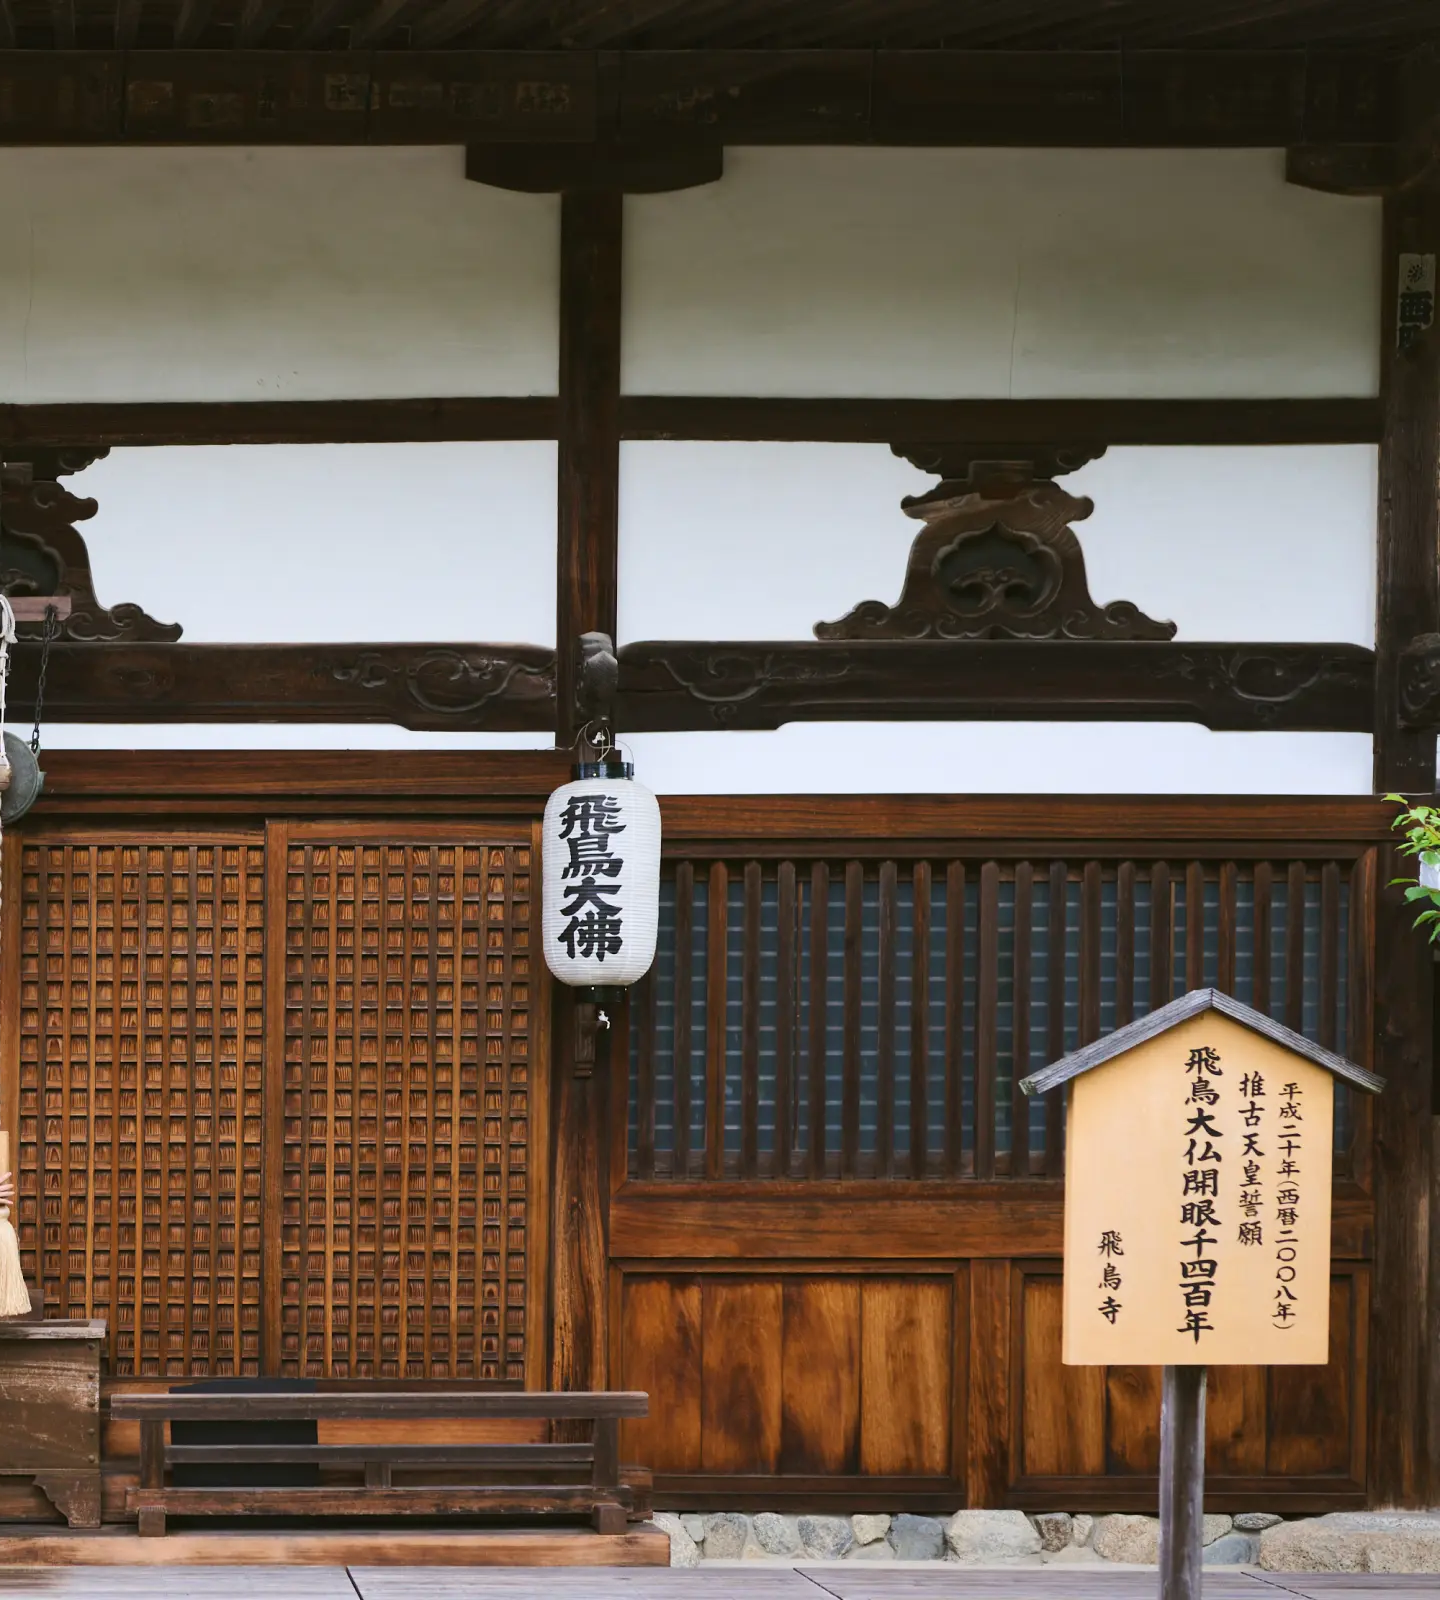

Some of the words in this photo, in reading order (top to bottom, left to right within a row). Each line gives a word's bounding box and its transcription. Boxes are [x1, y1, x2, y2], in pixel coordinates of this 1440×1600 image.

[558, 794, 626, 962] 飛鳥大佛
[1177, 1046, 1223, 1345] 飛鳥大仏開眼千四百年
[1238, 1071, 1266, 1246] 推古天皇誓願
[1097, 1230, 1125, 1325] 飛鳥寺
